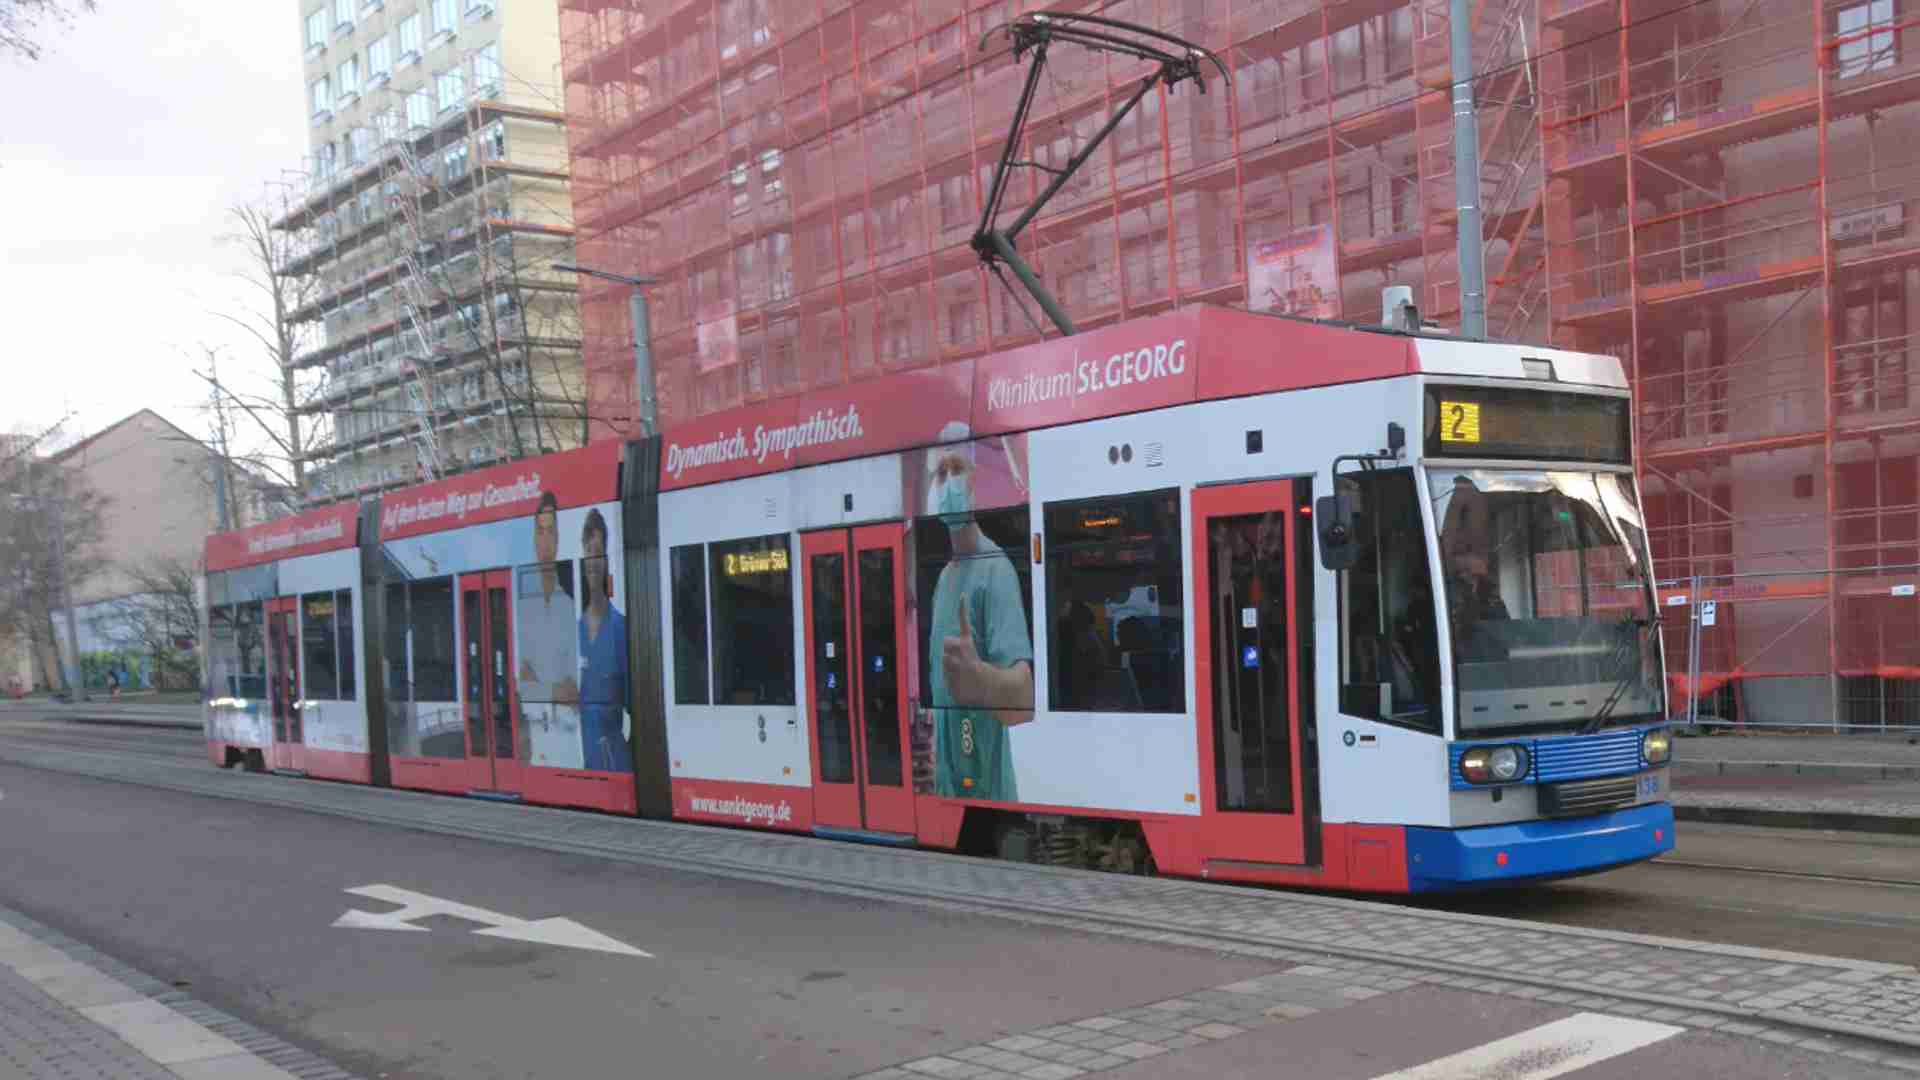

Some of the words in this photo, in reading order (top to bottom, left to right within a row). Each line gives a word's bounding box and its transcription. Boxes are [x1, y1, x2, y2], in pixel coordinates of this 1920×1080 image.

[986, 370, 1073, 412] Klinikum
[1076, 339, 1185, 394] St.GEORG
[666, 426, 749, 480] Dynamisch.
[752, 403, 864, 464] Sympathisch.
[1451, 404, 1466, 439] 2
[691, 795, 792, 826] www.sanktgeorg.de
